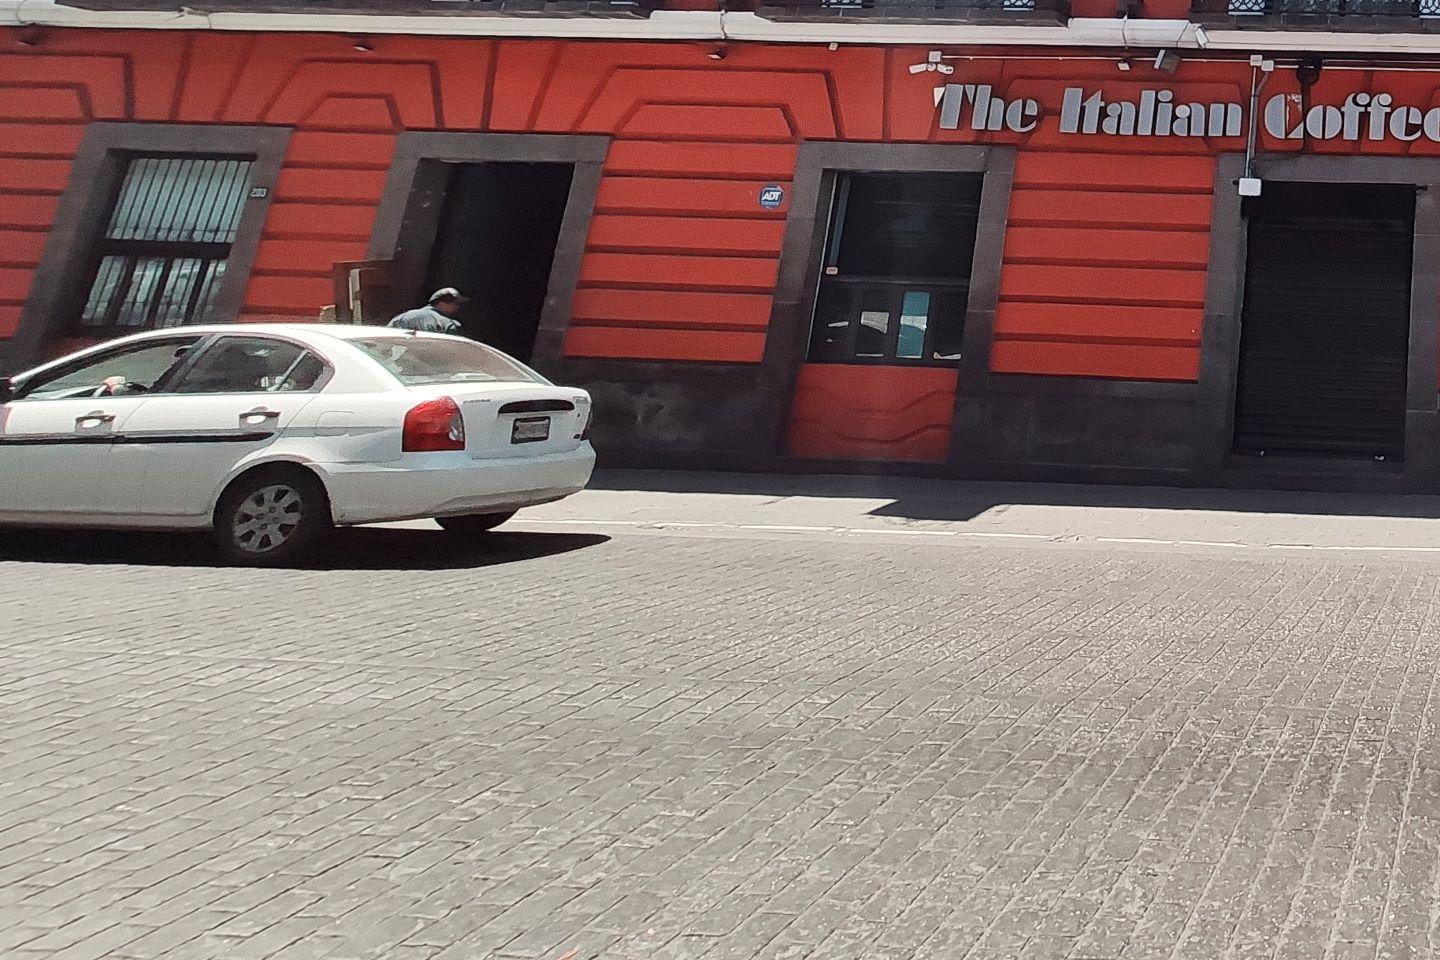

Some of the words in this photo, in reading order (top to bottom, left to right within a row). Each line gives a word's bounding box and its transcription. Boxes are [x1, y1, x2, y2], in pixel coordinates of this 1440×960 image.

[933, 83, 1038, 133] The
[1059, 87, 1243, 137] Italian
[761, 191, 782, 201] ADT
